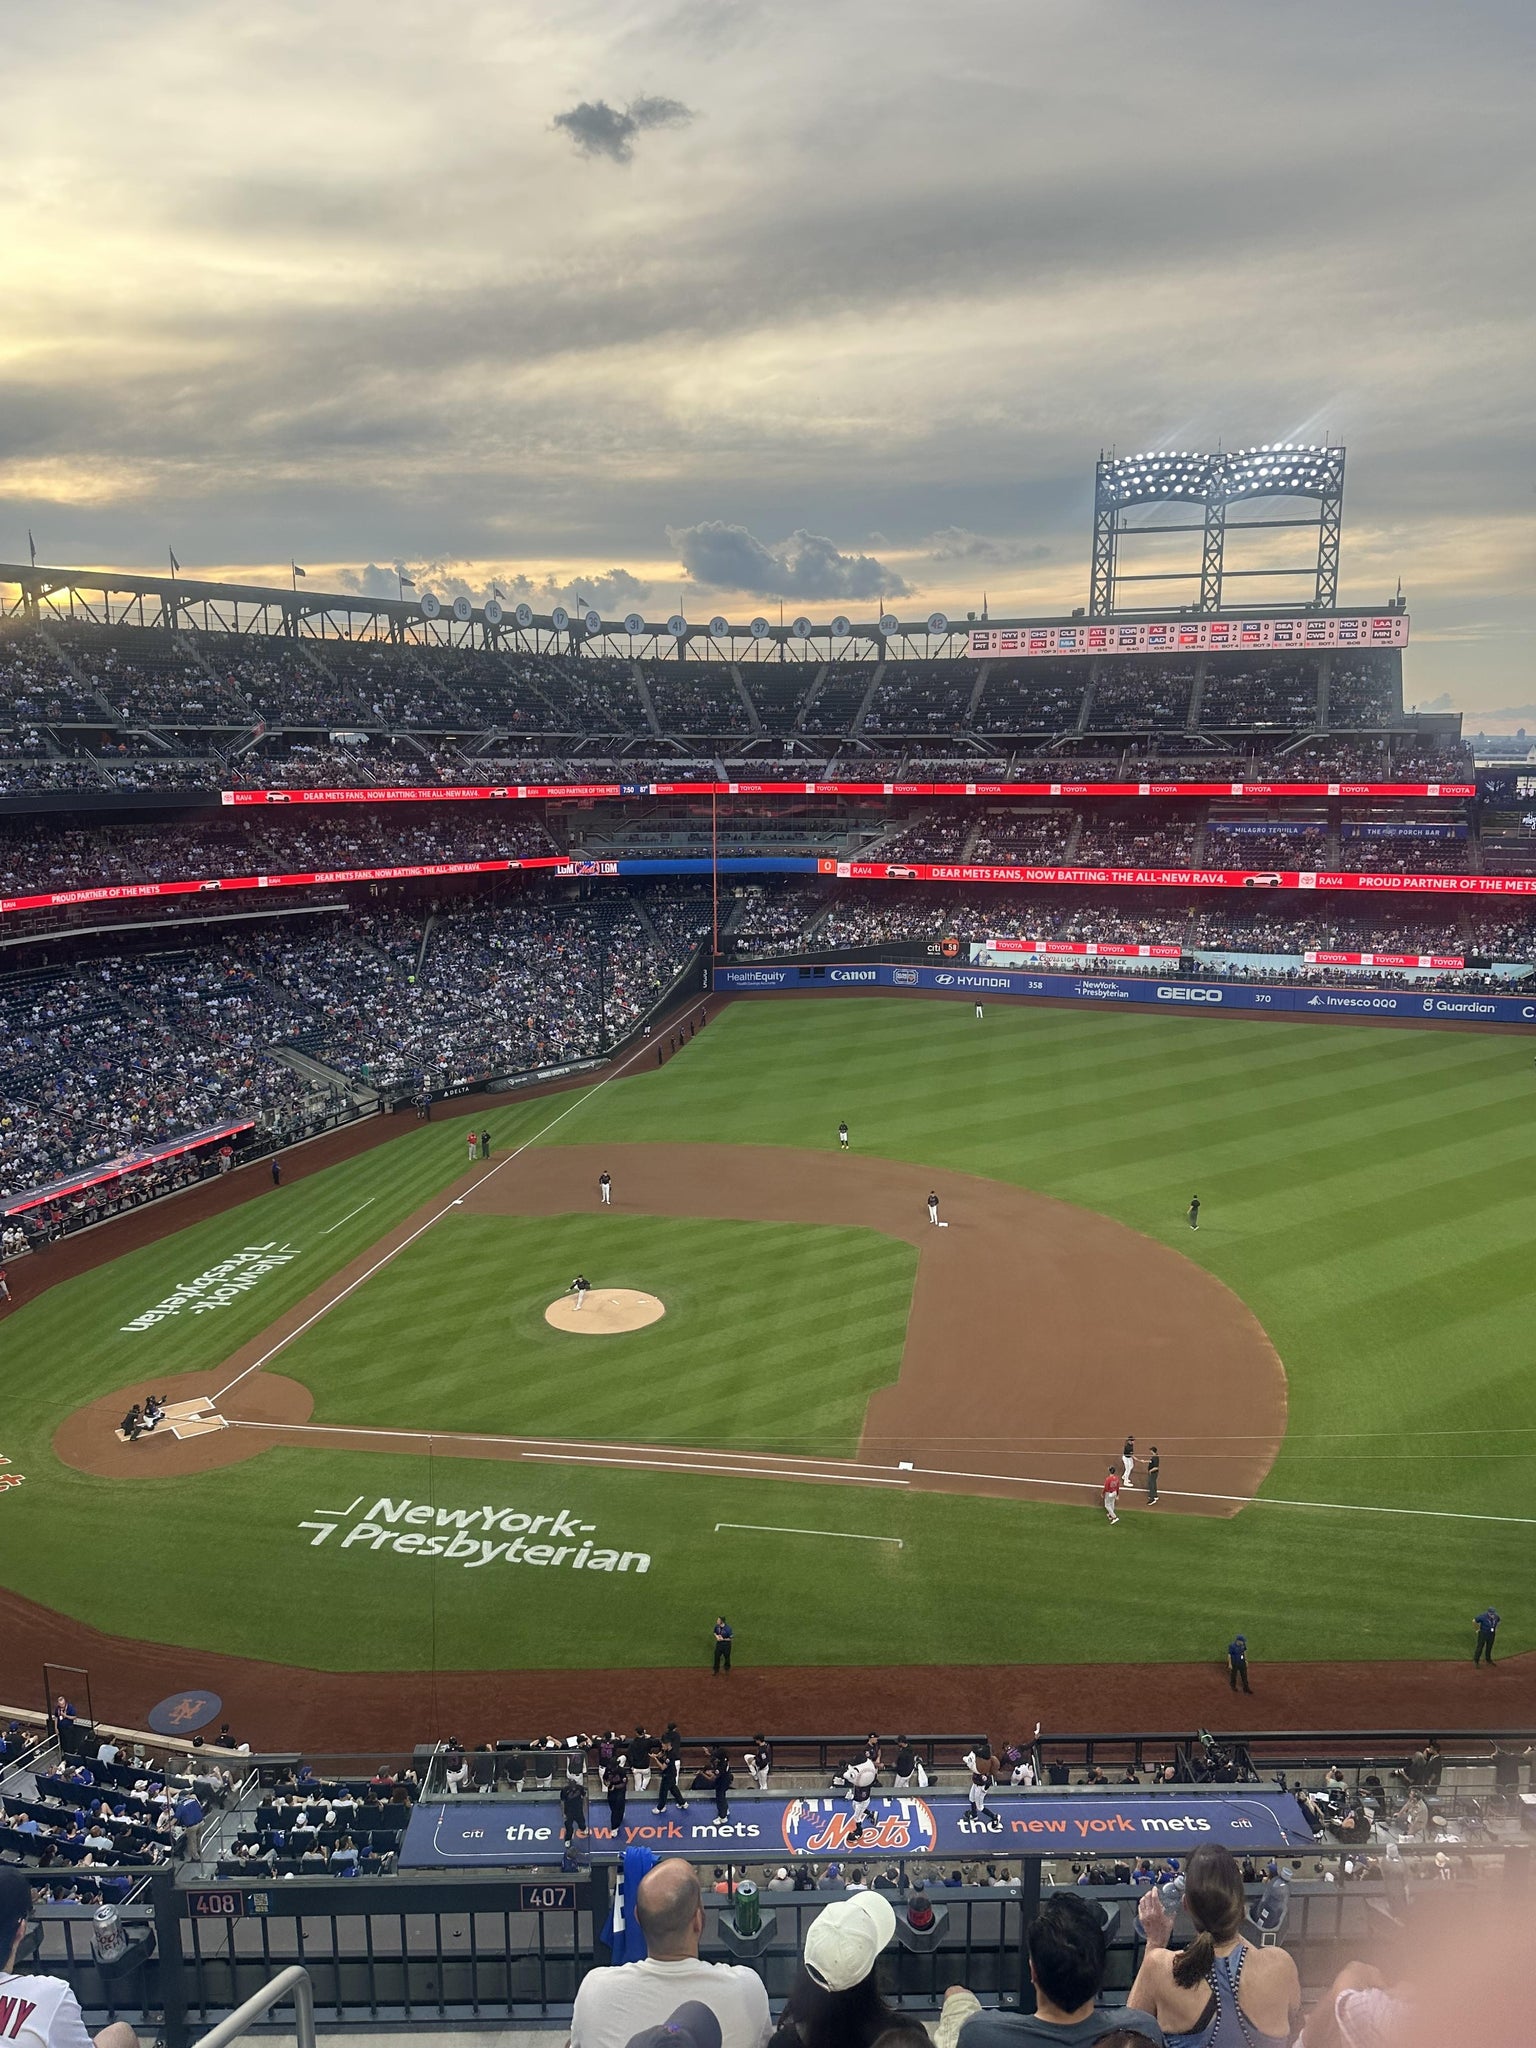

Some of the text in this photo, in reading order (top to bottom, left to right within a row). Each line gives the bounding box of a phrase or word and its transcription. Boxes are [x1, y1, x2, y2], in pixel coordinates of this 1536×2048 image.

[428, 600, 433, 611] 5
[459, 602, 467, 614] 18
[489, 607, 498, 618] 16
[520, 610, 529, 620] 24
[556, 614, 564, 624] 17
[589, 616, 598, 627] 36
[932, 620, 944, 629] 42
[630, 620, 639, 630] 31
[673, 621, 682, 631] 41
[714, 623, 723, 632] 14
[755, 624, 765, 632] 37
[881, 620, 898, 630] SHEA
[346, 791, 366, 800] FANS,
[387, 790, 417, 798] BATTING:
[601, 863, 617, 873] LGM
[824, 862, 831, 870] 0
[315, 864, 481, 882] DEAR METS FANS, NOW BATTING: THE ALL-NEW RAV4.
[932, 868, 1227, 884] DEAR METS FANS, NOW BATTING: THE ALL-NEW RAV4.
[1319, 877, 1343, 885] RAV4
[1359, 877, 1536, 891] PROUD PARTNER OF THE METS
[52, 886, 160, 904] PROUD PARTNER OF THE METS
[927, 943, 940, 951] citi
[727, 972, 785, 982] HealthEquity
[830, 970, 876, 981] Canon
[958, 976, 1010, 988] HYUNDAI
[1083, 981, 1118, 990] NewYork-
[1083, 988, 1129, 998] Presbyterian
[1157, 987, 1222, 1002] GEICO
[1255, 994, 1271, 1003] 370
[1327, 996, 1396, 1008] Invesco QQQ
[1437, 1001, 1495, 1012] Guardian
[450, 1087, 469, 1095] DELTA
[189, 1254, 294, 1314] NewYork-
[120, 1253, 262, 1331] Presbyterian
[364, 1498, 596, 1538] NewYork-
[341, 1522, 651, 1572] Presbyterian
[807, 1813, 911, 1850] Mets
[958, 1815, 1252, 1837] the new york mets citi
[462, 1828, 484, 1838] citi
[506, 1824, 551, 1841] the
[624, 1821, 683, 1843] york
[692, 1822, 760, 1838] mets
[530, 1888, 566, 1906] 407
[197, 1895, 234, 1914] 408
